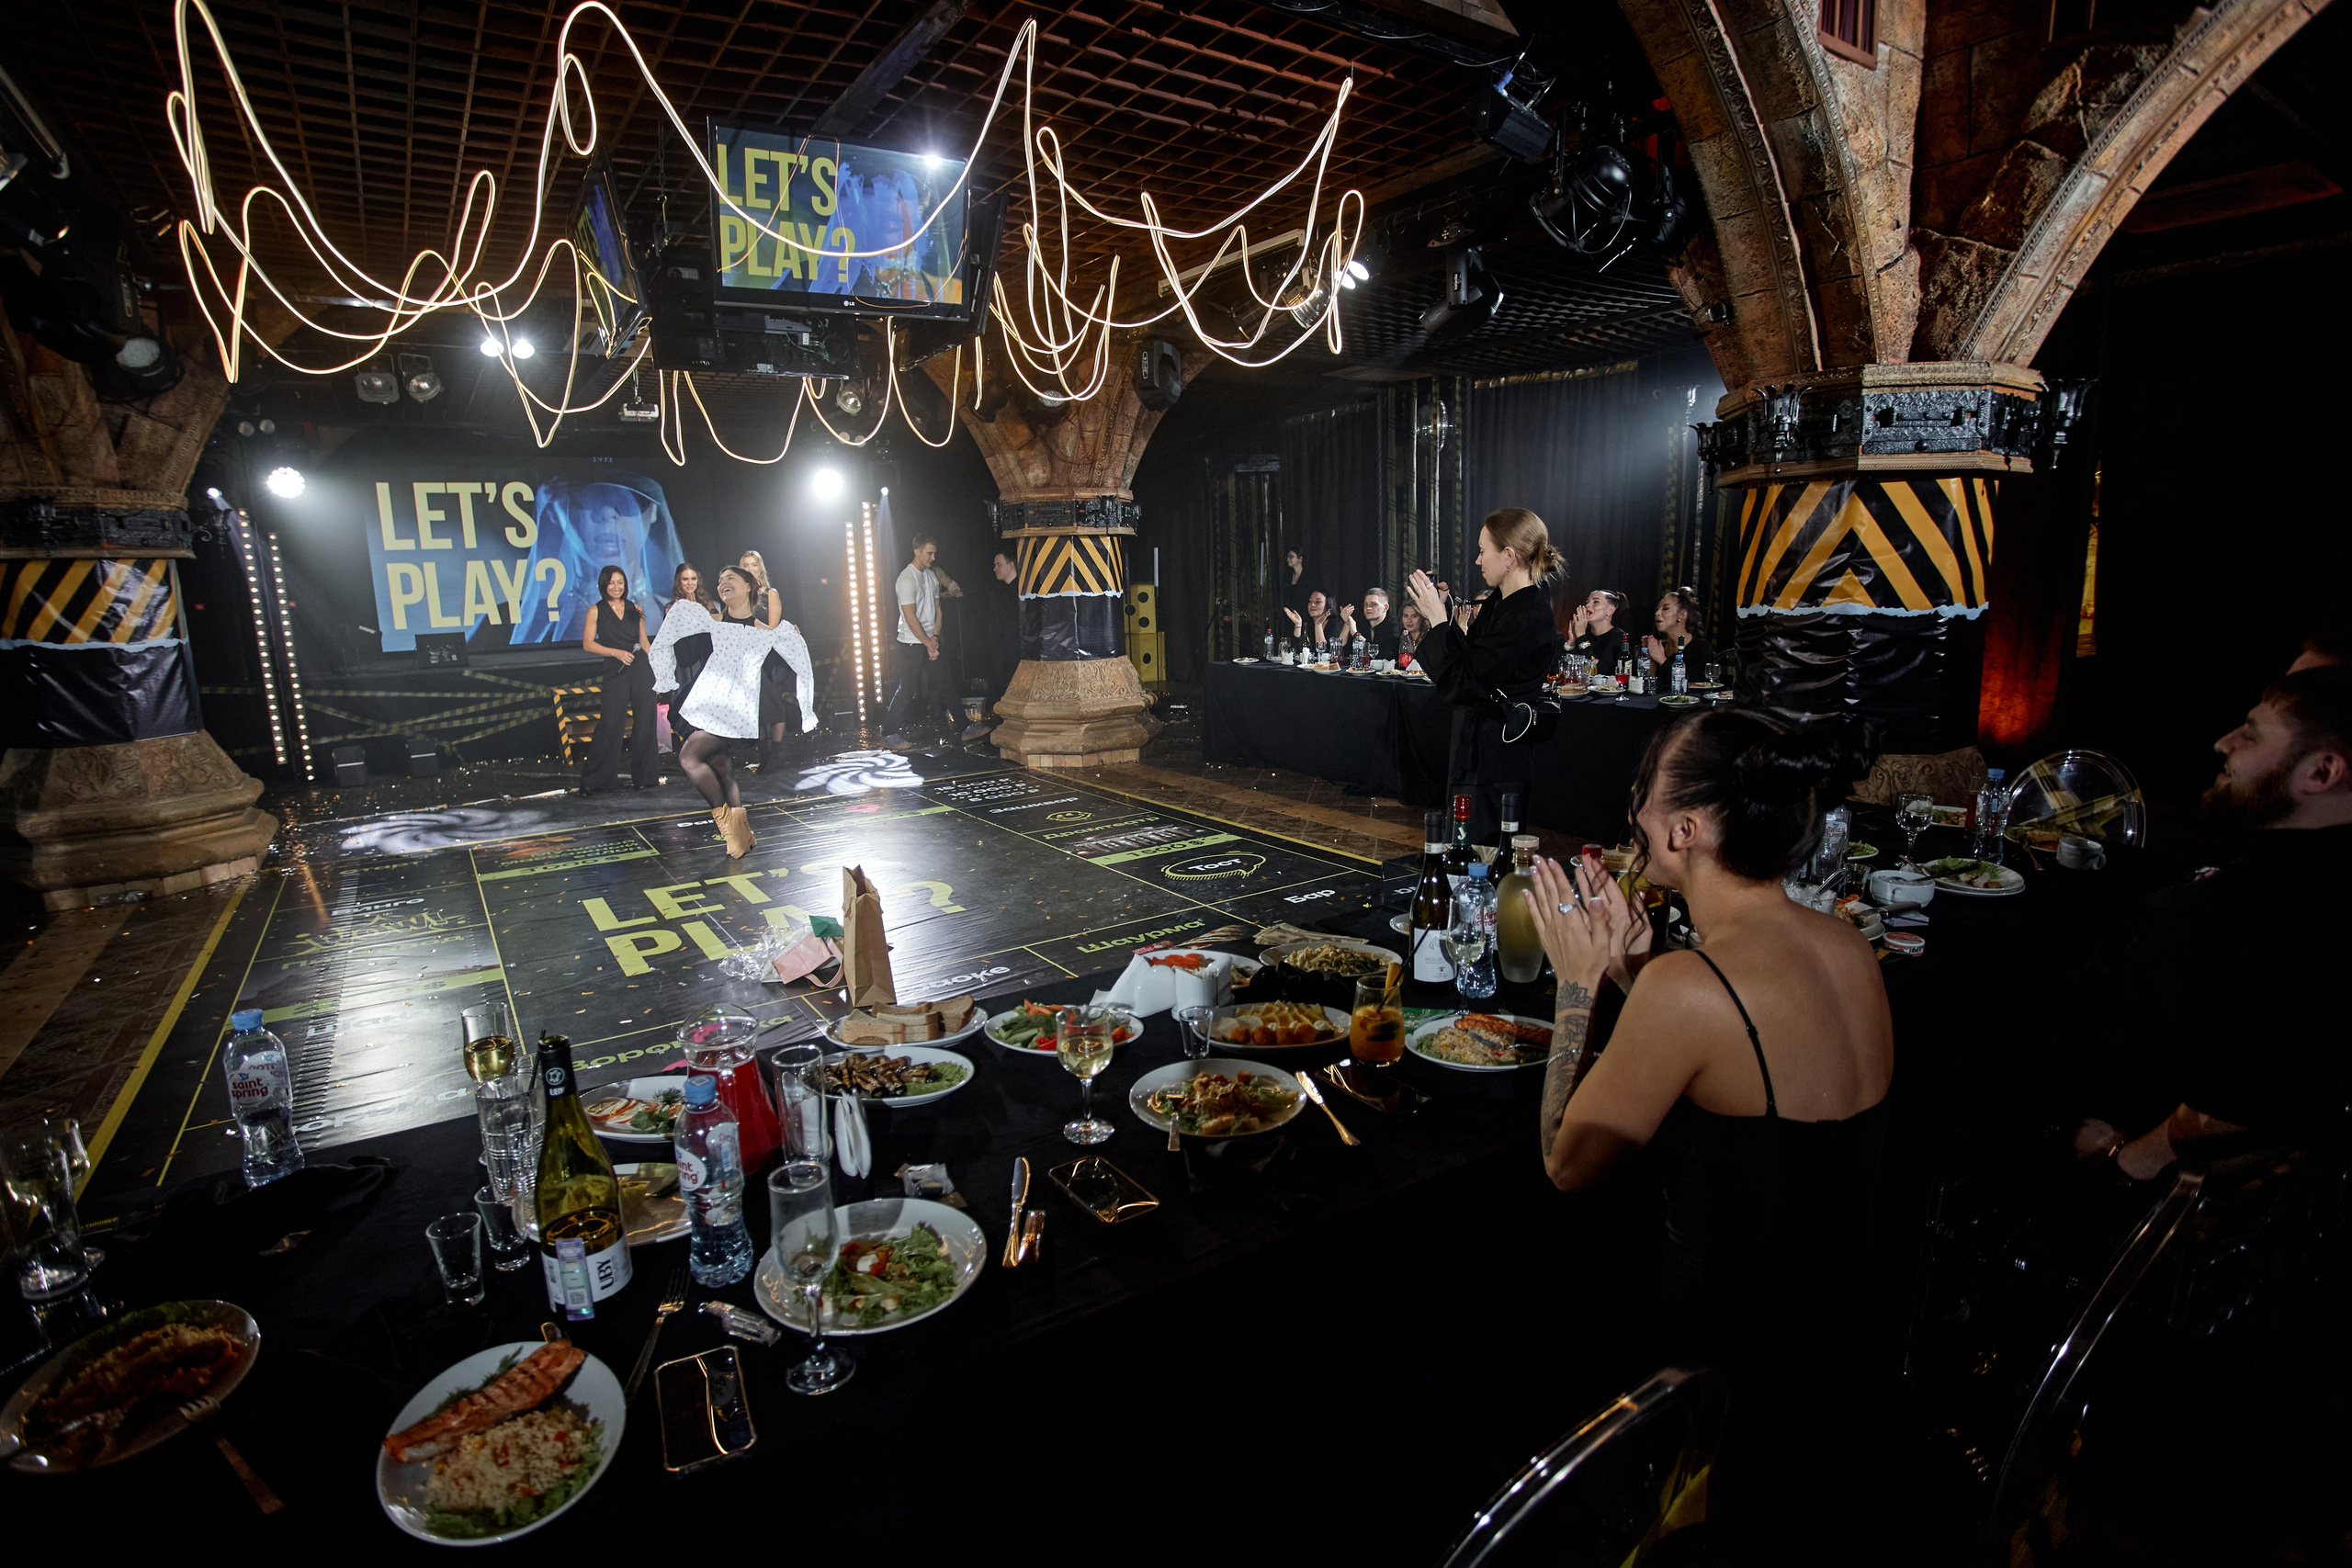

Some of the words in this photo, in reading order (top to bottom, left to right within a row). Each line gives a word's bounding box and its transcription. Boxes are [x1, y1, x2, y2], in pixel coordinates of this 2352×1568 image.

[716, 143, 837, 216] LET'S
[719, 215, 856, 282] PLAY?
[375, 480, 538, 551] LET'S
[386, 557, 567, 630] PLAY?
[1043, 815, 1160, 840] Драмтеатр
[1188, 858, 1242, 872] Тост
[1283, 887, 1337, 904] Бар
[1077, 919, 1206, 953] Шаурма
[231, 1086, 269, 1100] spring
[232, 1077, 263, 1089] saint
[291, 1088, 468, 1134] юрьма
[596, 1258, 615, 1291] UBY
